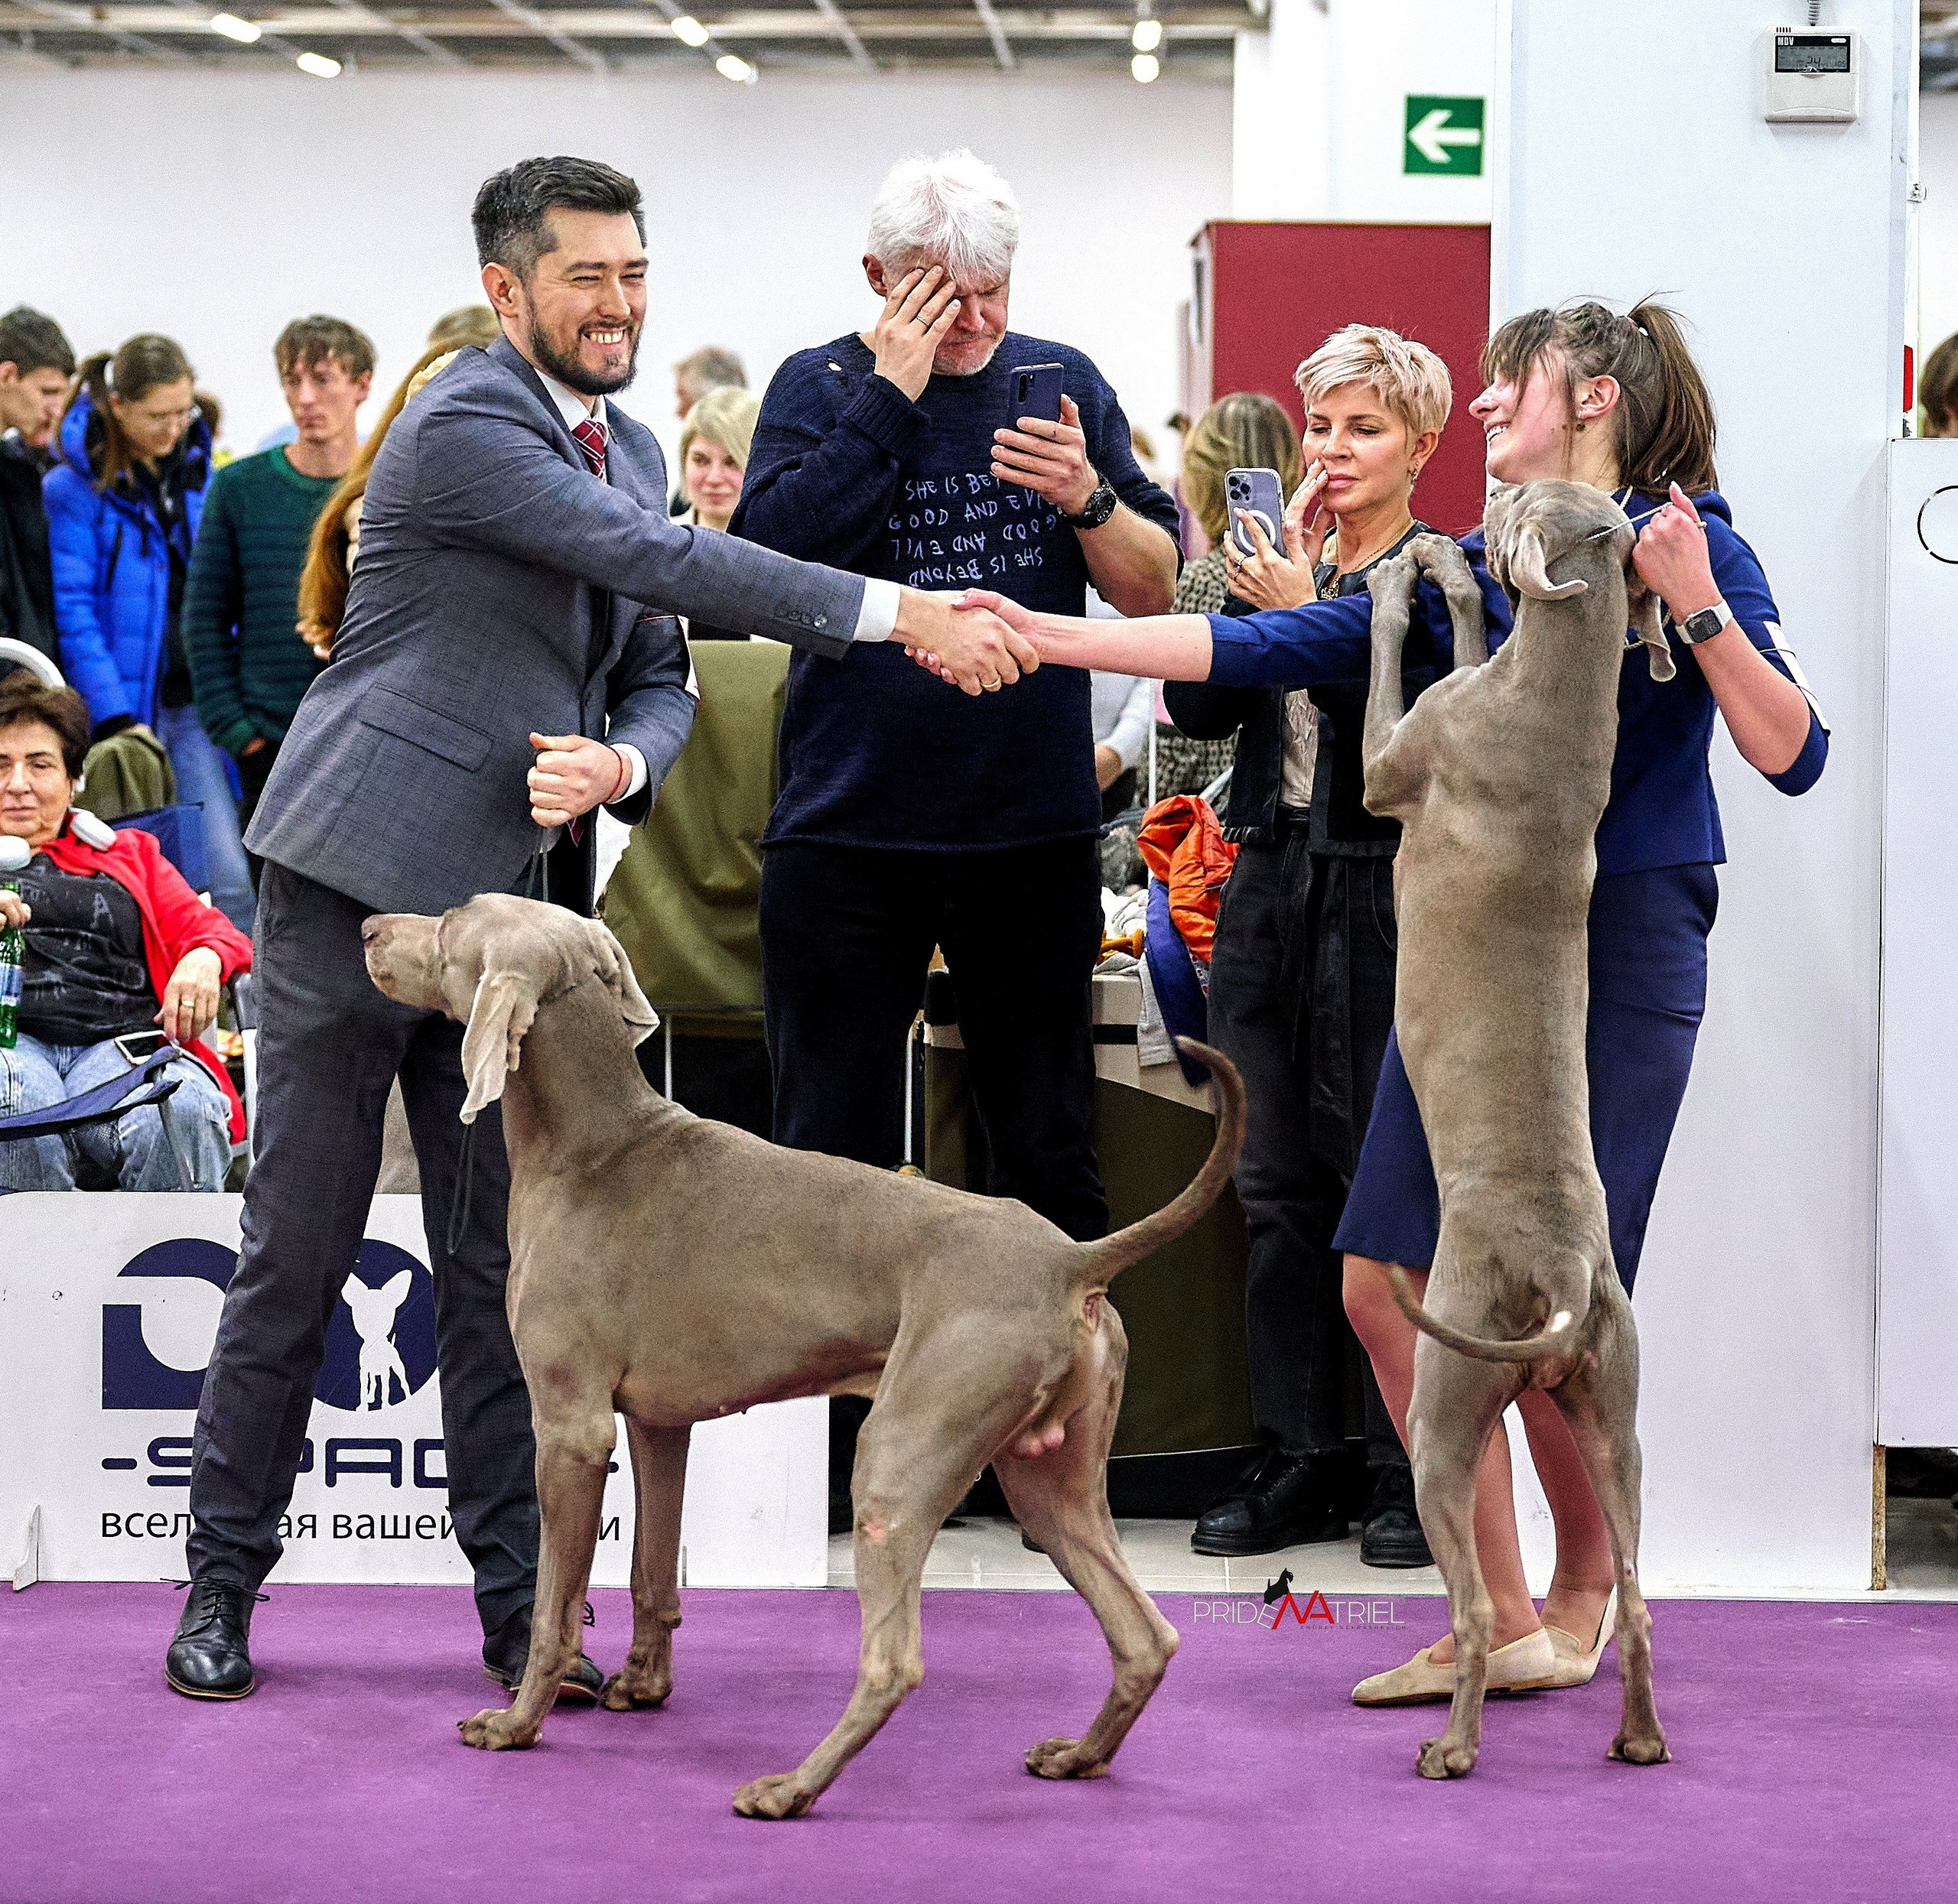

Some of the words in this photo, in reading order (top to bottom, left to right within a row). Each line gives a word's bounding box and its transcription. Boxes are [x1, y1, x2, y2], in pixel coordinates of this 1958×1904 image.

[1777, 37, 1794, 45] MDV
[905, 479, 938, 501] SHE
[945, 476, 959, 495] IS
[889, 508, 948, 530] GOOD
[964, 501, 998, 522] AND
[1005, 488, 1042, 510] EVI
[1003, 514, 1056, 541] GOOD
[891, 538, 944, 561] EVIL
[952, 531, 987, 552] AND
[990, 554, 1007, 573] IS
[1014, 546, 1043, 567] SHE
[909, 558, 983, 587] BEYOND
